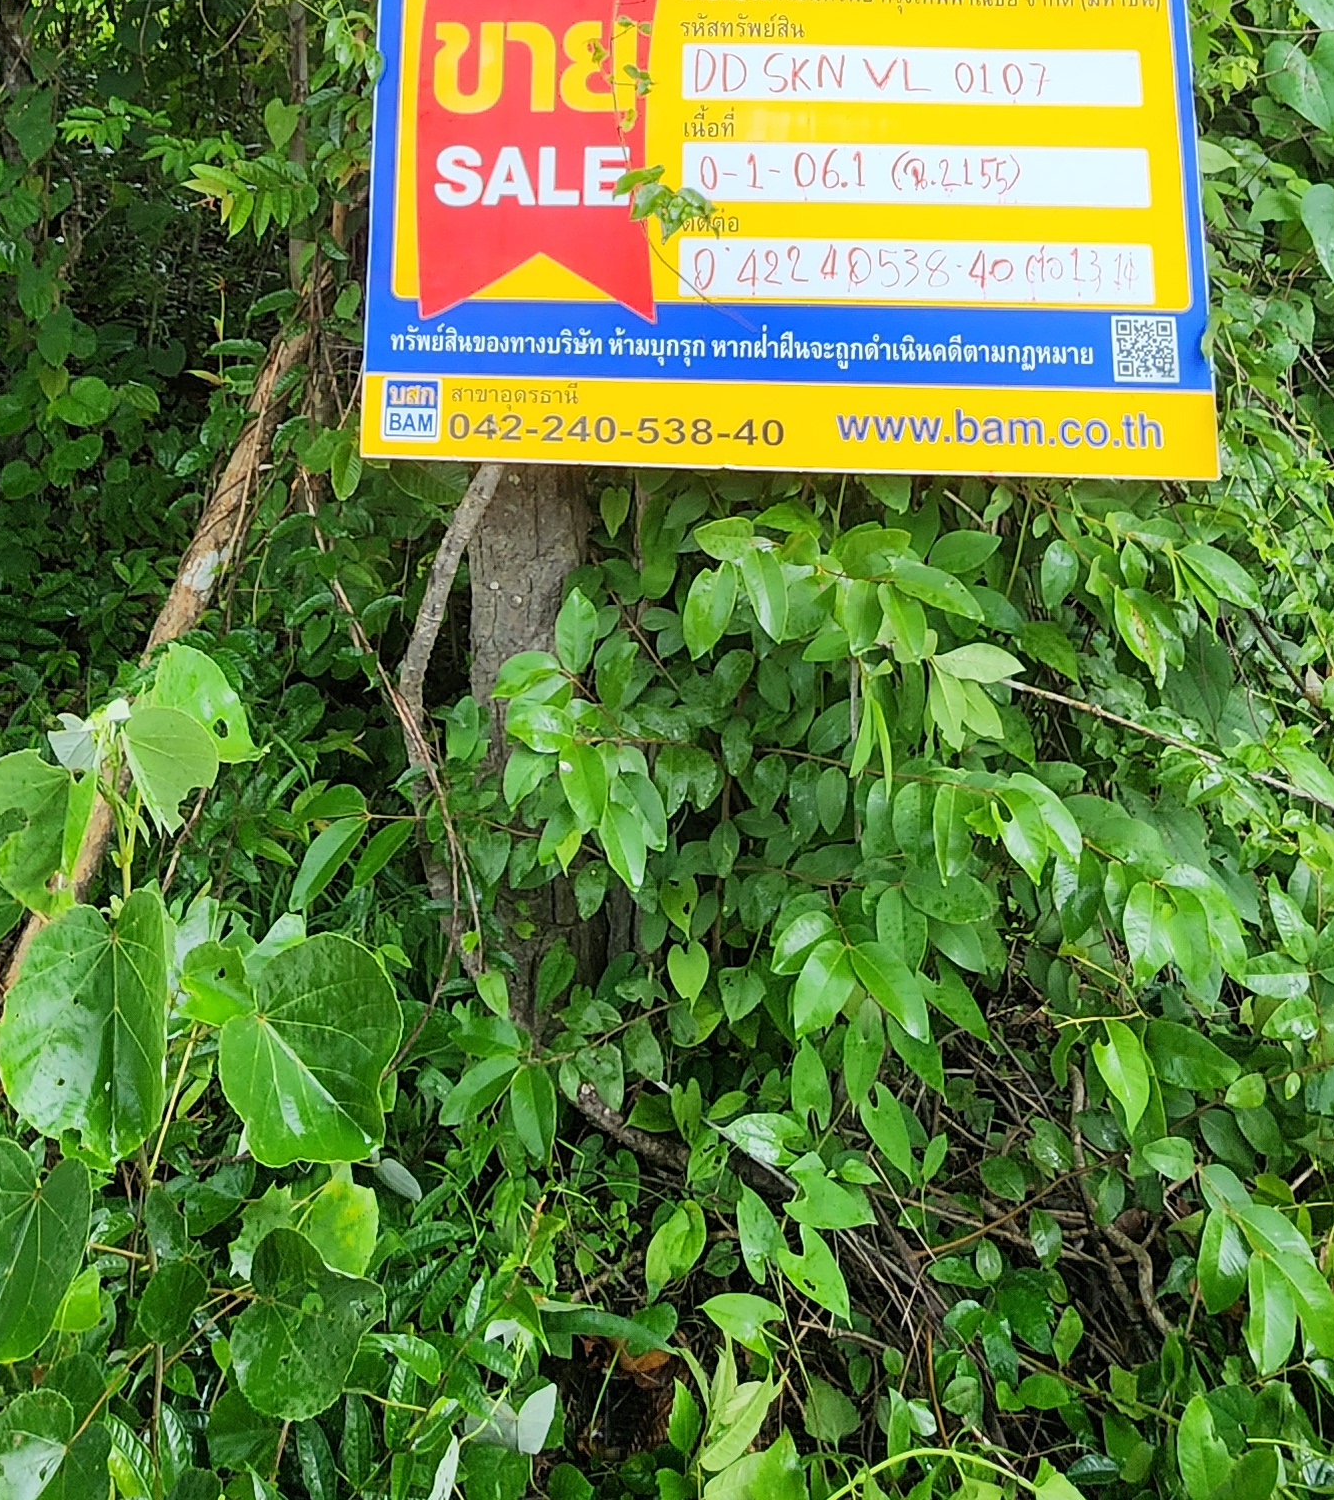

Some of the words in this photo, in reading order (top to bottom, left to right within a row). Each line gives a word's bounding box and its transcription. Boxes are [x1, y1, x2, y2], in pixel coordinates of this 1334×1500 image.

[680, 12, 805, 38] รหัสทรัพย์สิน
[433, 21, 638, 114] ขาย
[694, 48, 747, 93] DD
[763, 52, 845, 93] SKN
[862, 56, 932, 91] VL
[954, 61, 1051, 97] 0107
[683, 104, 735, 138] เนื้อที่
[433, 145, 630, 207] SALE
[390, 323, 603, 355] ทรัพย์สินของทางบริษัท
[609, 327, 706, 367] ห้ามบุกรุก
[451, 383, 579, 411] สาขาอุดรธานี
[389, 412, 434, 432] BAM
[449, 413, 784, 447] 042-240-538-40
[835, 407, 1165, 449] www.bam.co.th
